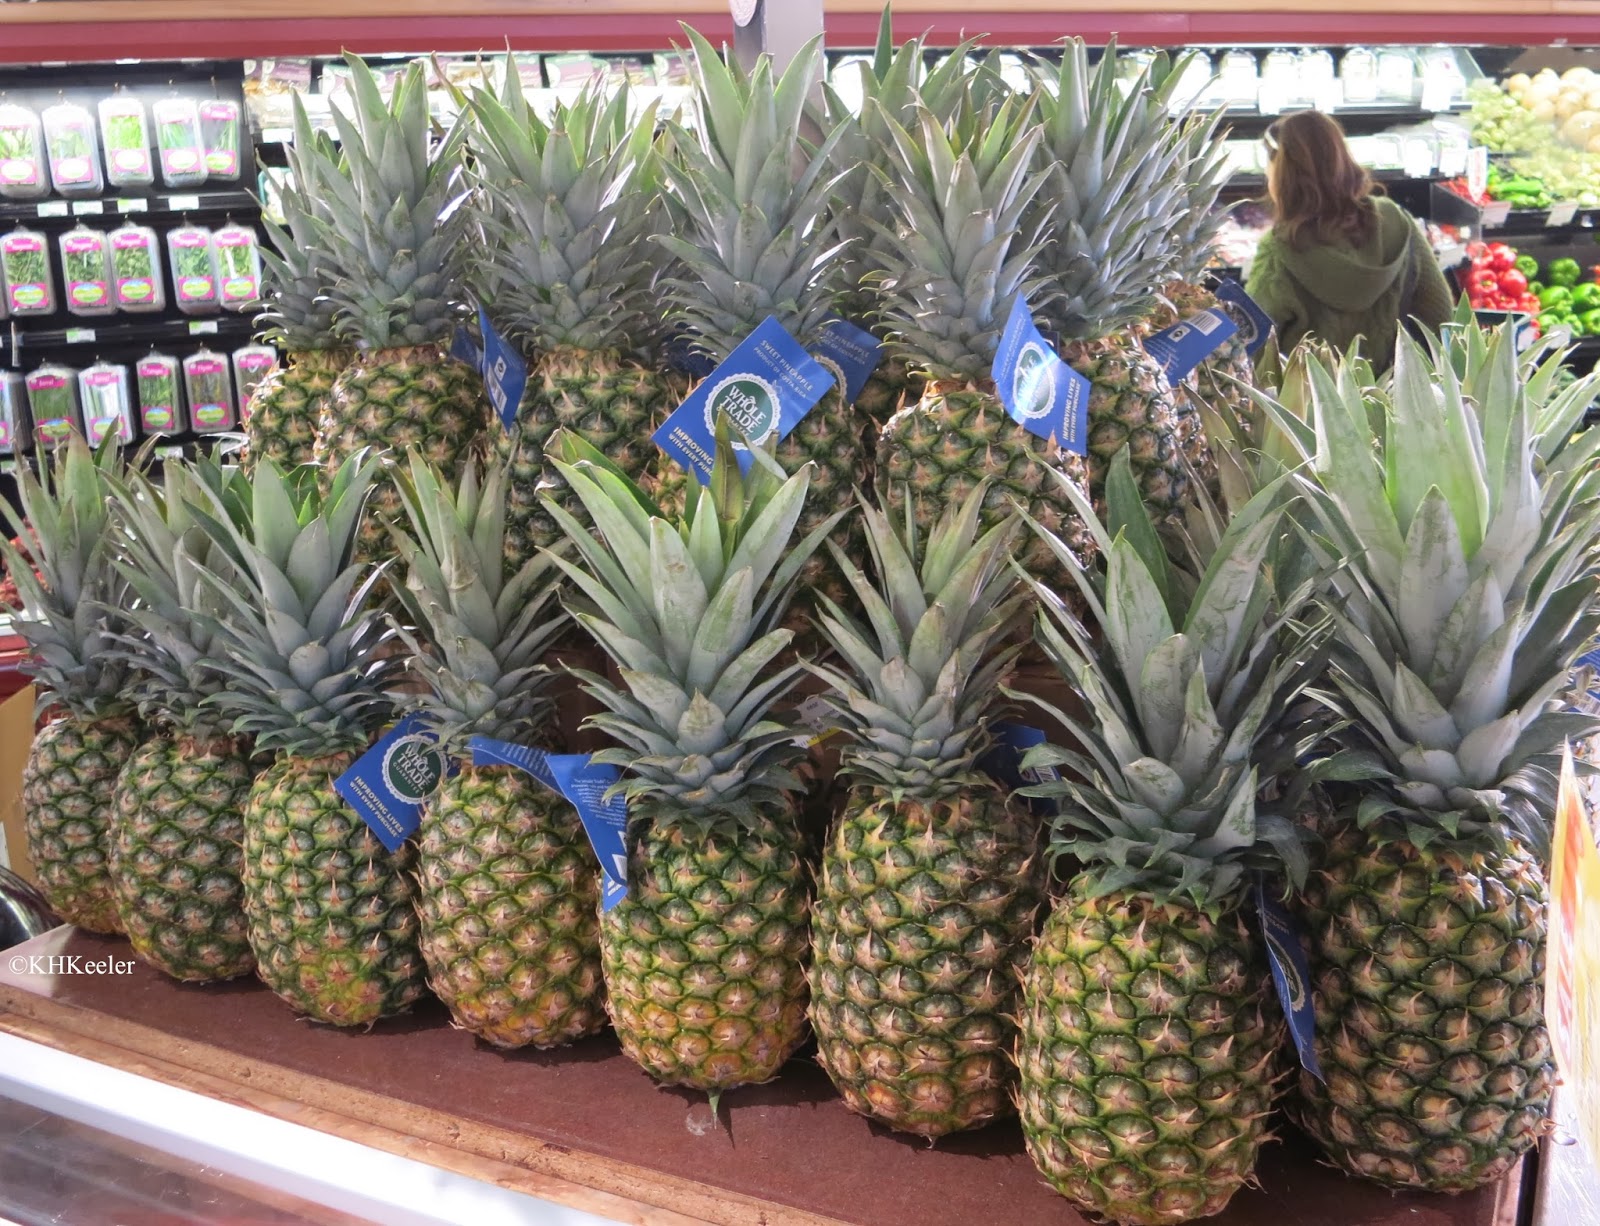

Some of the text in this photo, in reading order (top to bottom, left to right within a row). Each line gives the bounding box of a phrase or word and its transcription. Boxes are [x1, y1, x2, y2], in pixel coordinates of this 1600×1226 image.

[760, 339, 813, 391] SWEET PINEAPPLE
[834, 334, 869, 357] PINEAPPLE
[753, 346, 773, 367] PRODUCT
[779, 372, 794, 387] COSTA
[794, 386, 806, 398] RICA
[719, 395, 758, 433] TRADE
[729, 385, 766, 424] WHOLE
[1061, 376, 1076, 439] IMPROVING LIVES
[668, 433, 713, 476] WITH EVERY PURC
[673, 426, 713, 464] IMPROVING
[392, 762, 419, 793] GUARANTEE
[396, 753, 428, 790] TRADE
[404, 744, 436, 782] WHOLE
[349, 781, 397, 837] WITH EVERY PURCHASE
[354, 775, 388, 814] IMPROVING
[386, 813, 403, 832] LIVES
